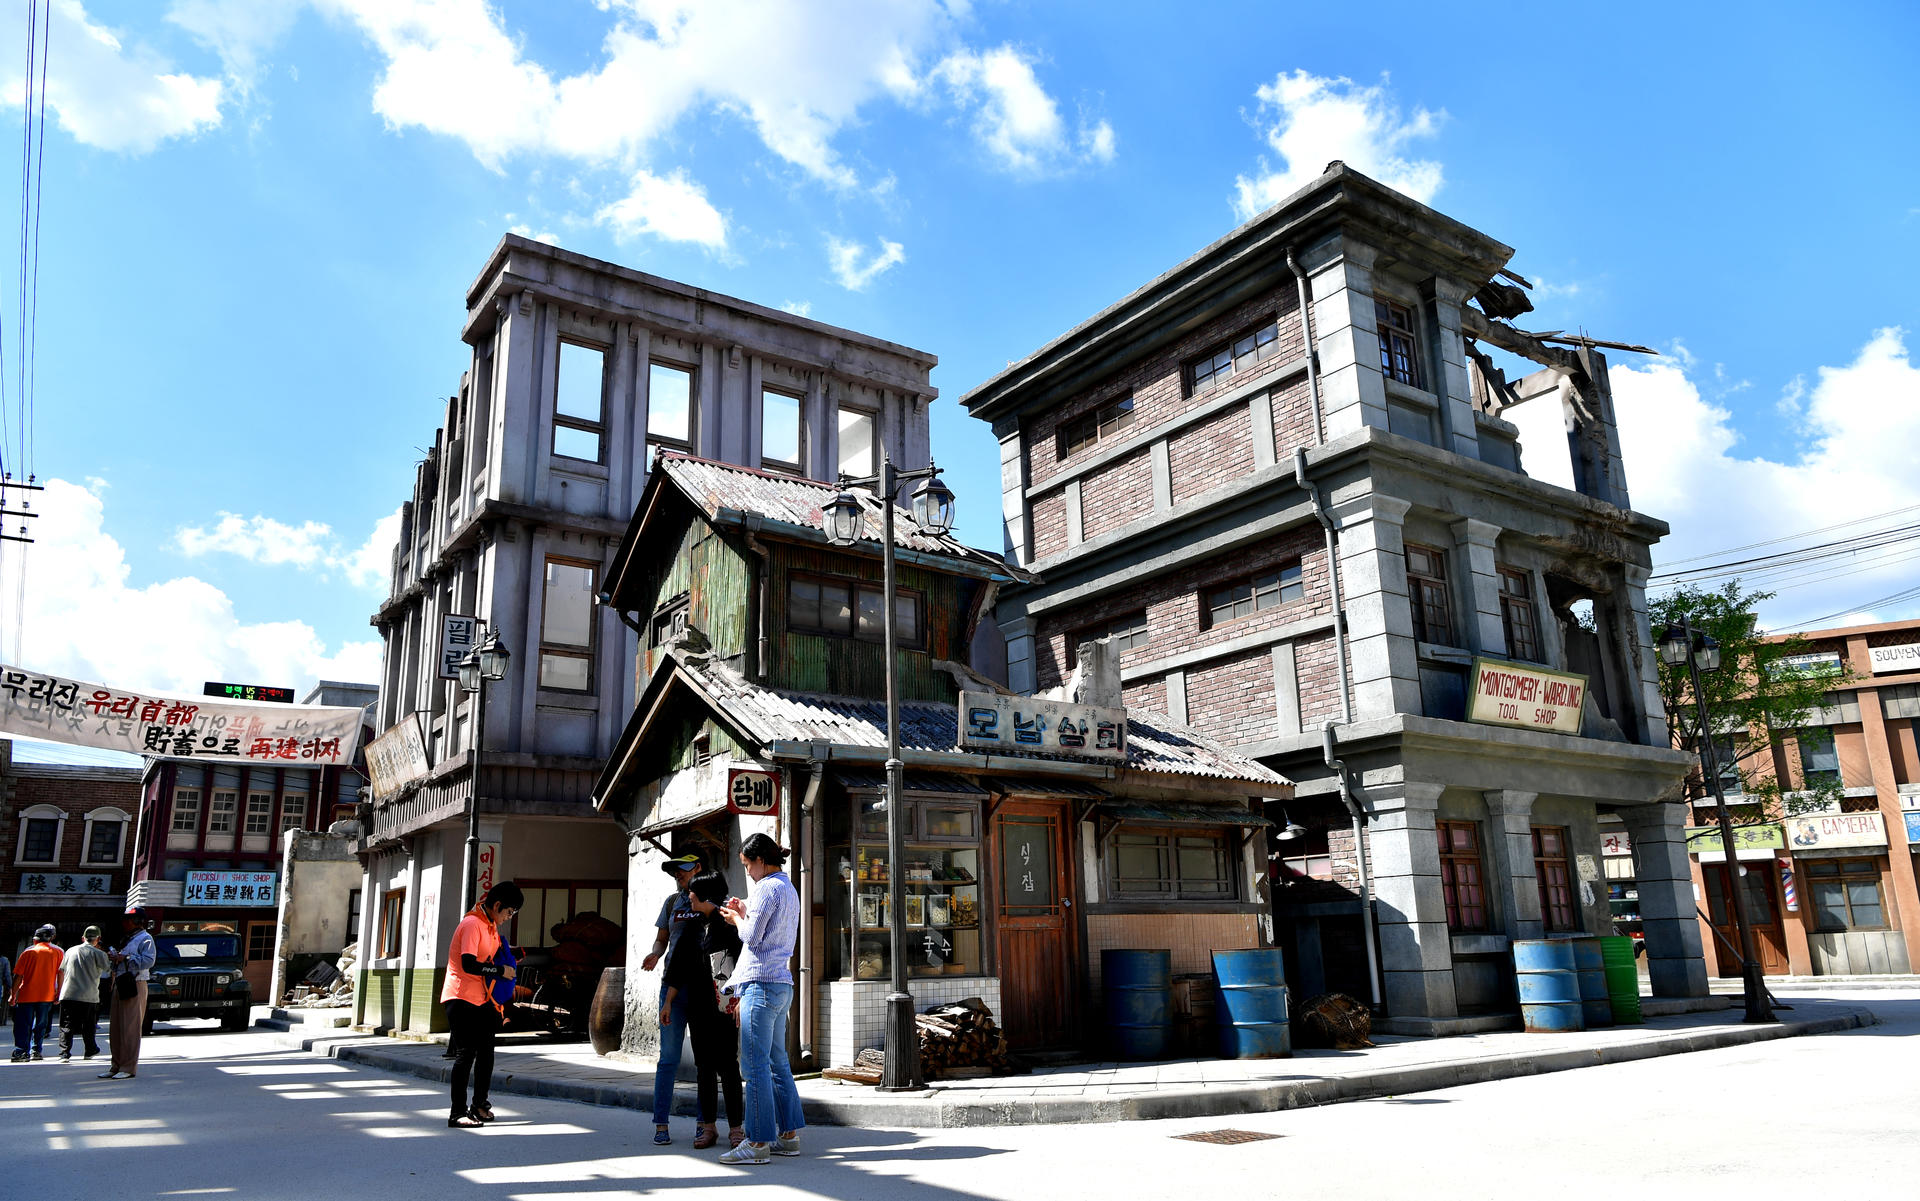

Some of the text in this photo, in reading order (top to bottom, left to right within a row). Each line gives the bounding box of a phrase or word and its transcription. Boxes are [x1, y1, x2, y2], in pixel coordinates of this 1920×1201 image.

[0, 666, 79, 710] 무러진
[246, 686, 255, 695] VS
[1499, 702, 1557, 725] TOOL SHOP
[733, 775, 773, 808] 담배
[1822, 815, 1877, 835] CAMERA
[231, 873, 249, 882] SHOE
[253, 874, 271, 882] SHOP
